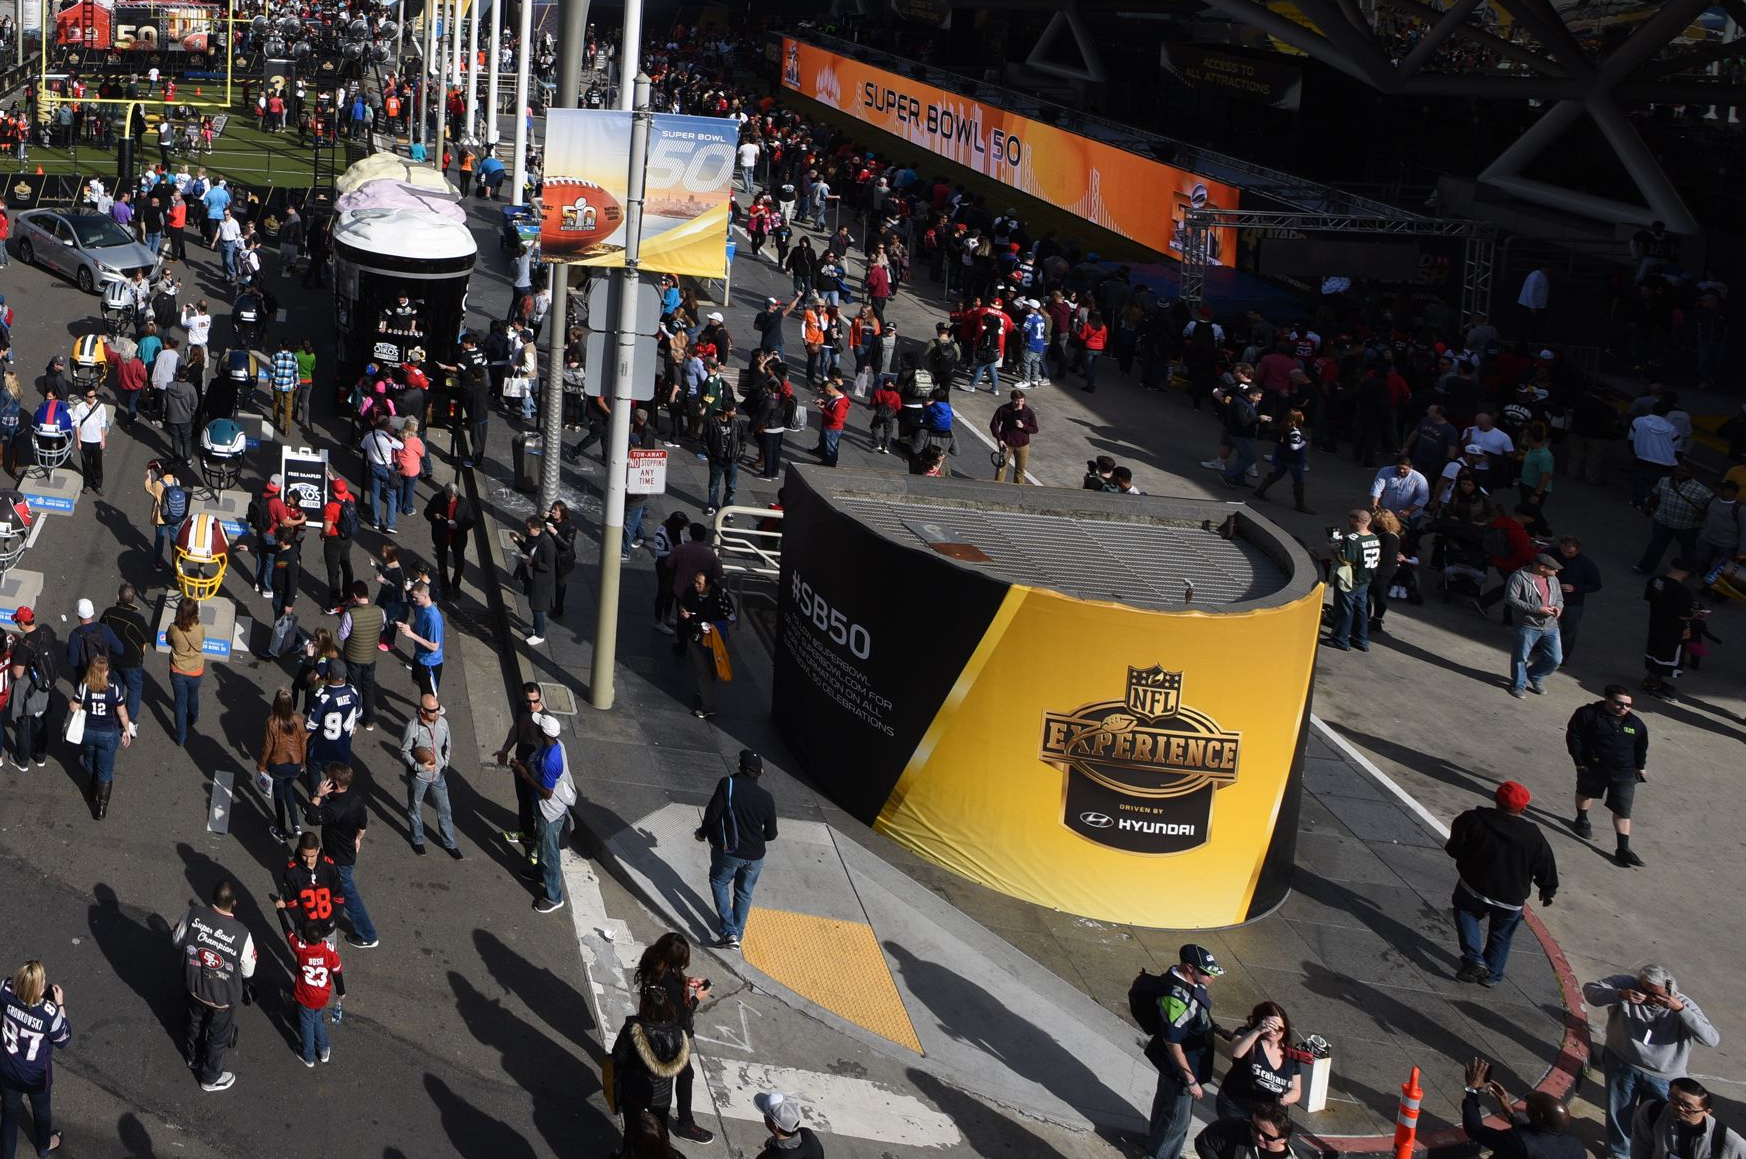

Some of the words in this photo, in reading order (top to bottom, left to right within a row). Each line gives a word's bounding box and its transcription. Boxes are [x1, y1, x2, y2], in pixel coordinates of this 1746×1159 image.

[1202, 56, 1239, 75] ACCESS
[1205, 72, 1271, 96] ATTRACTIONS
[661, 130, 695, 140] SUPER
[697, 133, 726, 143] BOWL
[864, 81, 921, 129] SUPER
[926, 106, 985, 155] BOWL
[991, 126, 1022, 168] 50
[646, 139, 736, 193] 50
[629, 458, 639, 468] NO
[640, 458, 666, 467] STOPPING
[640, 469, 654, 477] ANY
[639, 477, 654, 485] TIME
[791, 569, 871, 660] #SB50
[91, 702, 107, 716] 12
[336, 694, 352, 707] WARE
[822, 681, 895, 737] CELEBRATIONS
[862, 701, 883, 719] ALL
[868, 690, 893, 712] FOR
[1130, 687, 1175, 716] NFL
[324, 707, 357, 741] 94
[1046, 721, 1237, 770] EXPERIENCE
[1118, 803, 1151, 814] DRIVEN
[1152, 807, 1164, 815] BY
[1118, 817, 1195, 837] HYUNDAI
[300, 887, 332, 920] 28
[191, 917, 214, 938] Super
[214, 928, 236, 944] Bowl
[197, 932, 238, 957] Champions
[302, 965, 329, 988] 23
[6, 1003, 44, 1032] GRONKOWSKI
[2, 1016, 44, 1062] 87
